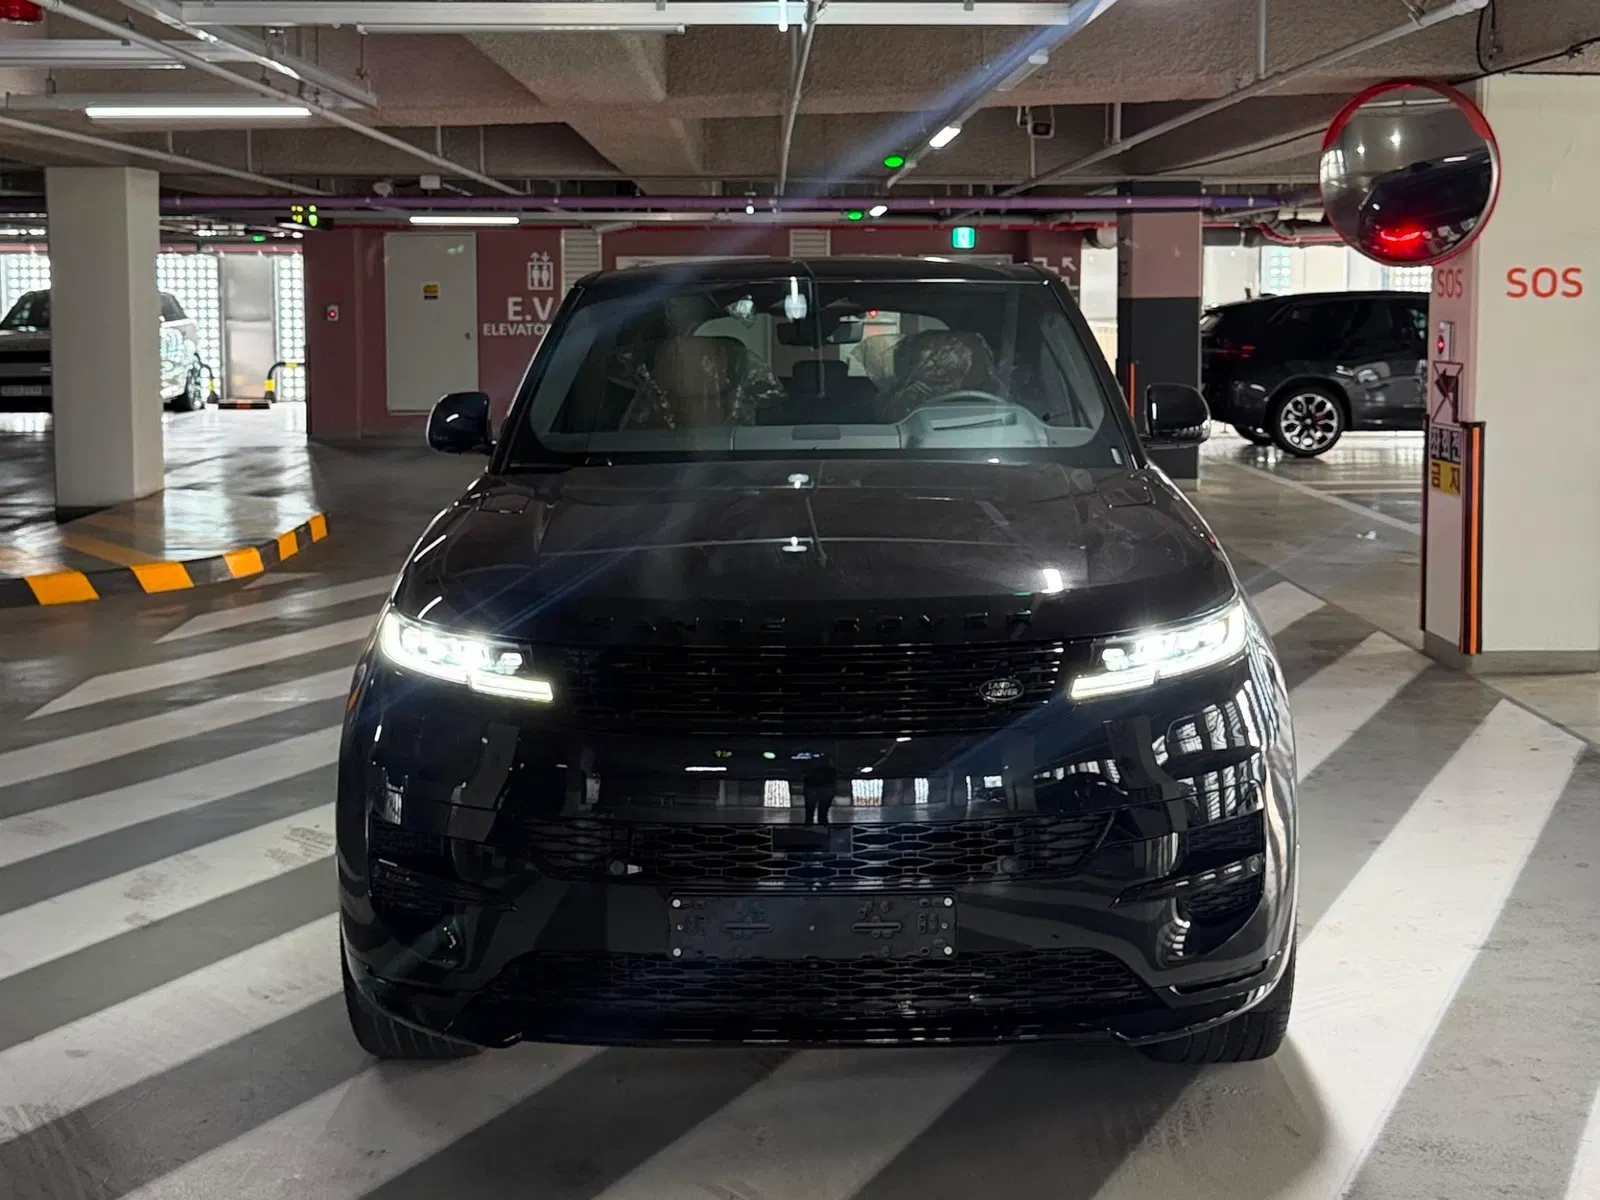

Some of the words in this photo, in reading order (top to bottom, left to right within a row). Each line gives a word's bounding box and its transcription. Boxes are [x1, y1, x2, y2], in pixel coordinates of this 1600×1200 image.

[1437, 269, 1464, 299] SOS
[1506, 267, 1583, 298] SOS
[483, 323, 551, 336] ELEVATO
